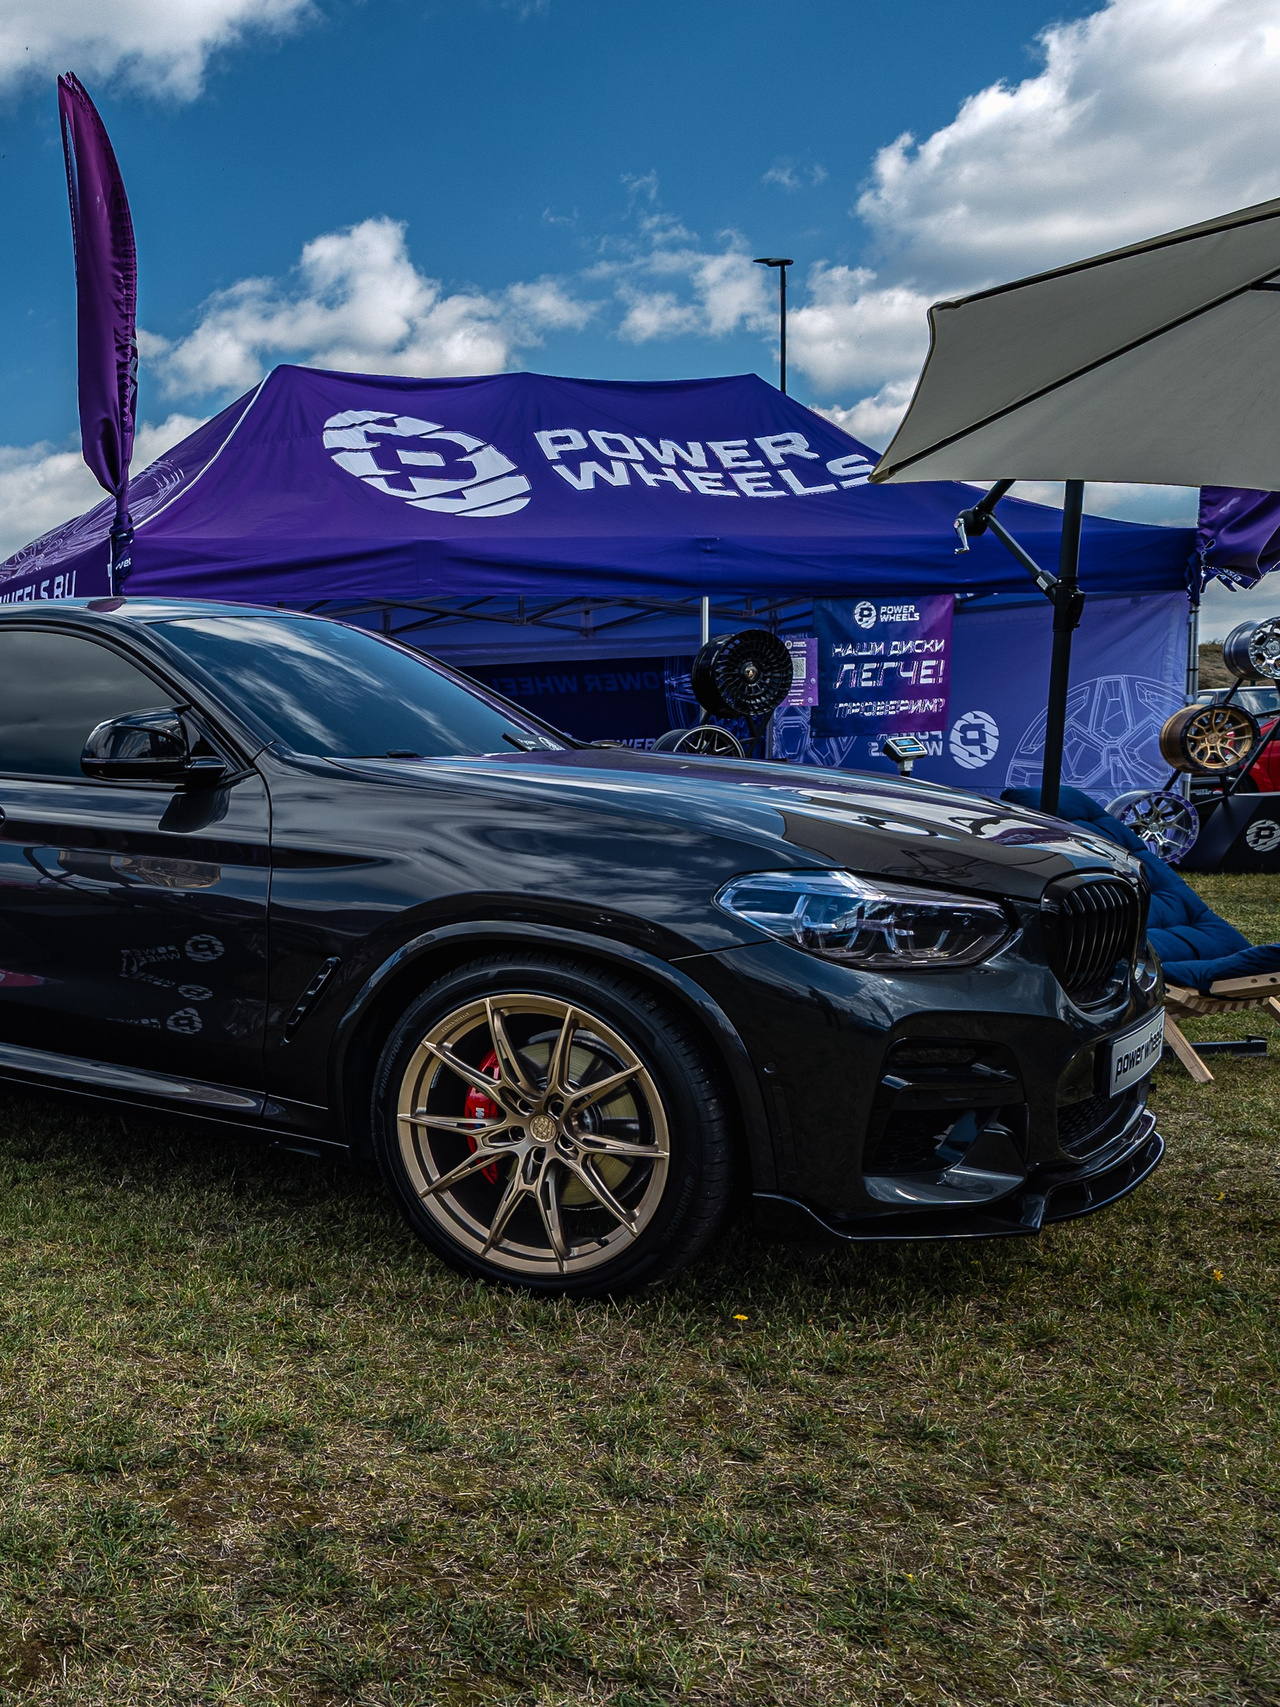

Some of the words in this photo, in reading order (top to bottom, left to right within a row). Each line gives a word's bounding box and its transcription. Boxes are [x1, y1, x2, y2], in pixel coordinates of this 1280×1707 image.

[534, 429, 820, 469] POWER
[552, 454, 874, 498] WHEELS
[880, 605, 915, 614] POWER
[880, 612, 919, 622] WHEELS
[832, 641, 885, 657] НАШИ
[887, 638, 945, 657] ДИСКИ
[832, 659, 946, 689] ЛЕГЧЕ!
[1115, 1044, 1144, 1082] power
